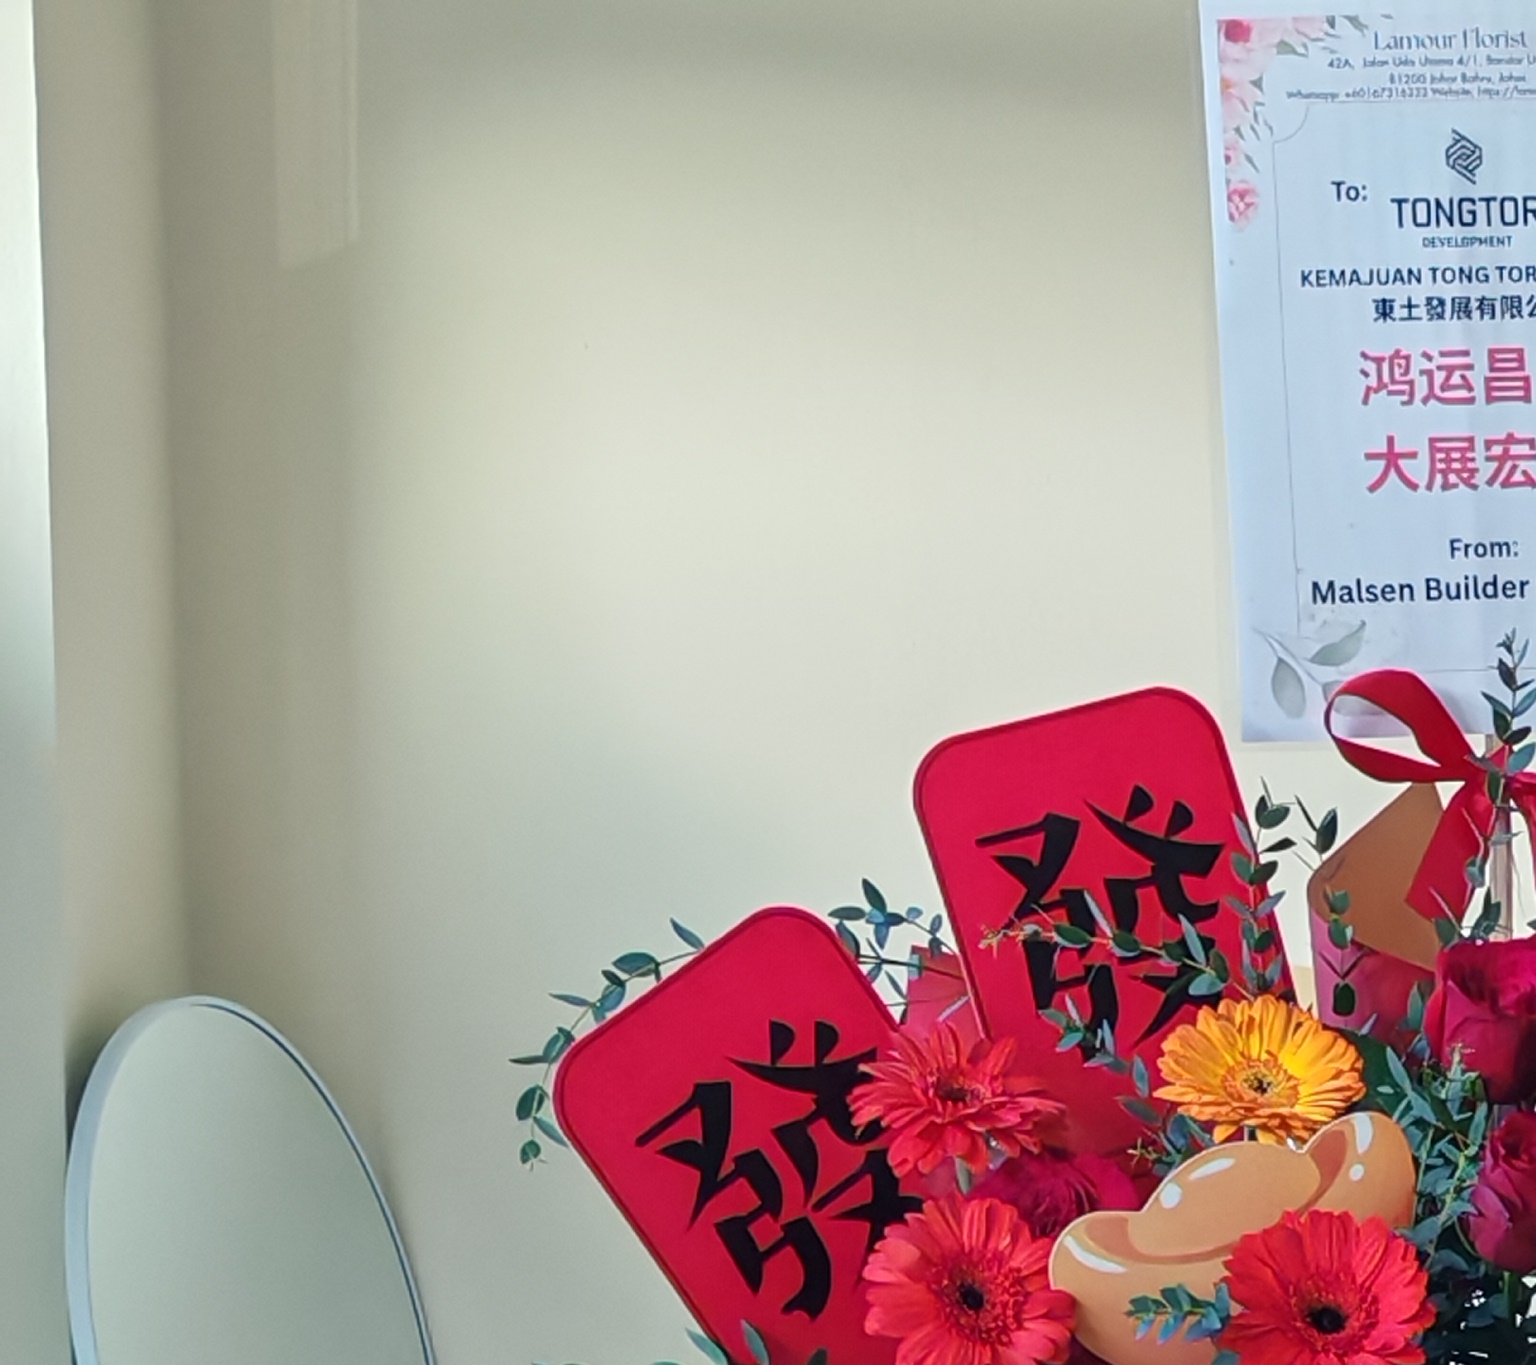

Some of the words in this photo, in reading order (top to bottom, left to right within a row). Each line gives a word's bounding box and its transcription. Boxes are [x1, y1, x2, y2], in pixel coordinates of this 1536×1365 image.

[1374, 30, 1457, 50] Lamour
[1462, 26, 1528, 49] Florist
[1330, 180, 1368, 202] To:
[1421, 235, 1513, 249] DEVELOPMENT
[1300, 266, 1422, 288] KEMAJUAN
[1428, 265, 1490, 286] TONG
[1449, 538, 1519, 560] From:
[1310, 577, 1416, 606] Malsen
[1424, 573, 1531, 602] Builder
